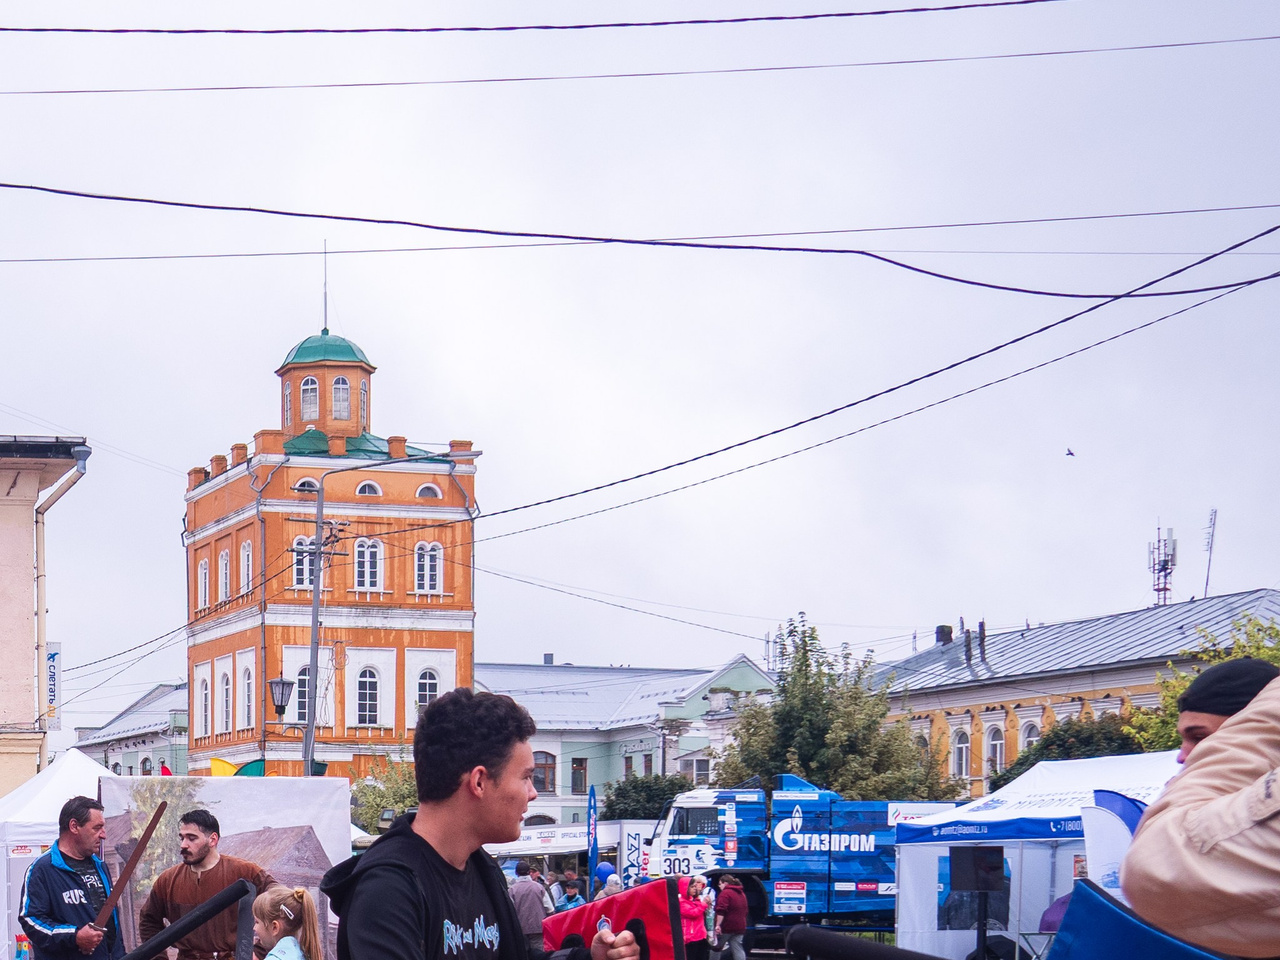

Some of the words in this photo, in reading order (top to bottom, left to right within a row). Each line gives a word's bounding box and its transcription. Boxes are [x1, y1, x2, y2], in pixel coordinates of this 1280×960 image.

[803, 833, 876, 852] ГАЗПРОМ
[663, 858, 691, 875] 303
[62, 889, 87, 905] RUS
